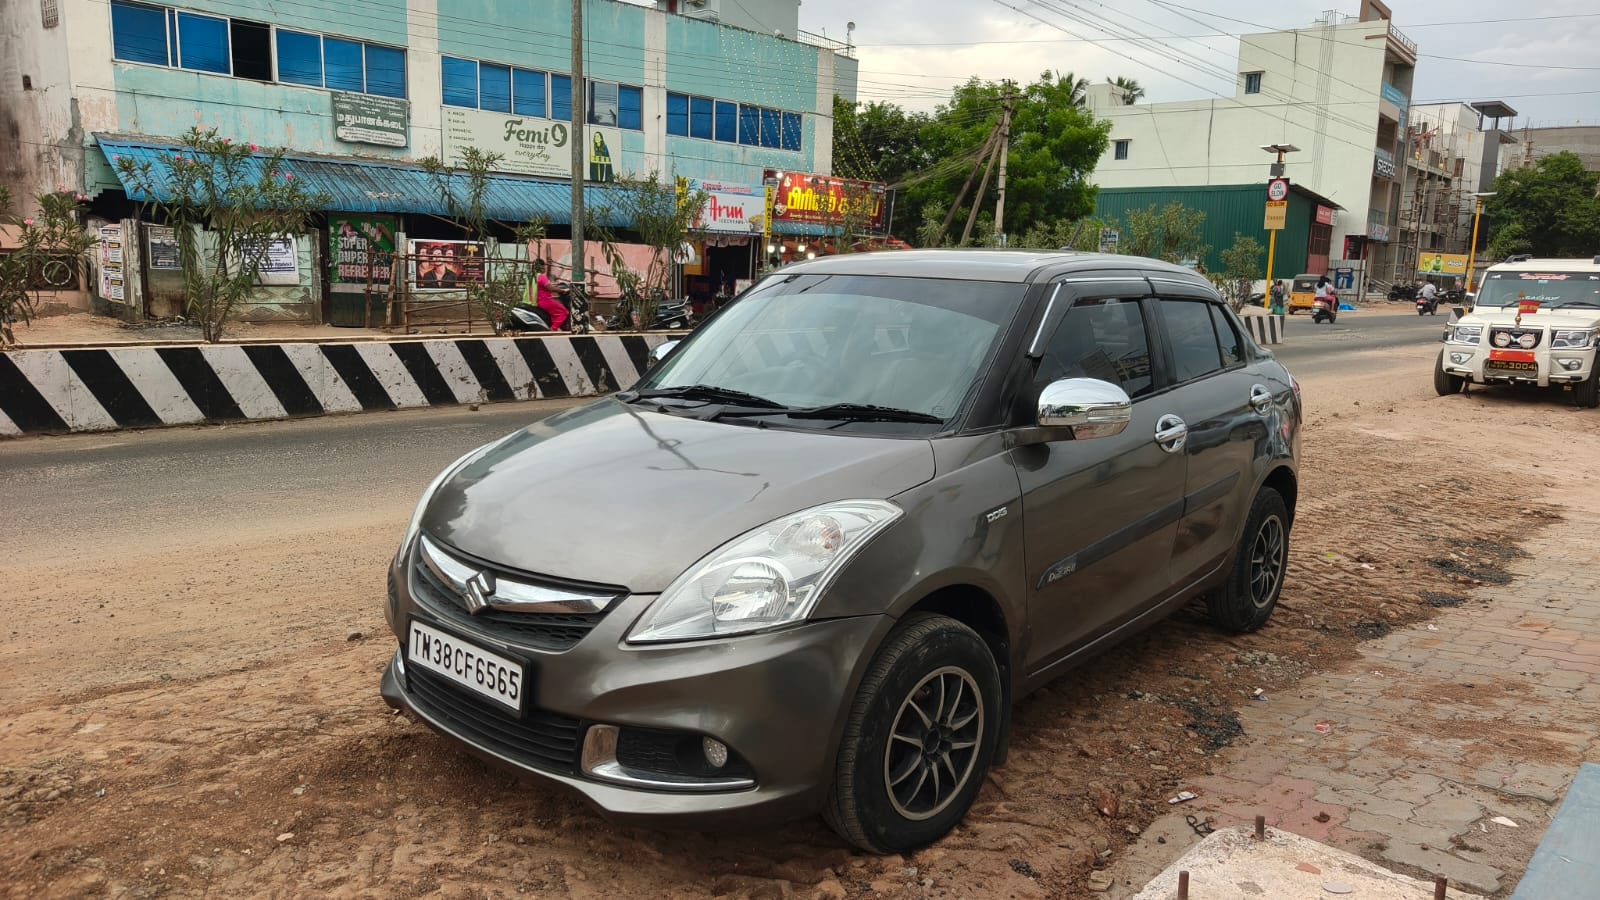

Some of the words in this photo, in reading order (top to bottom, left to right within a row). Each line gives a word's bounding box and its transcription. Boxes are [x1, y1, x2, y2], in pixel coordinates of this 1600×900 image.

[336, 113, 405, 131] மதுபானக்கடை
[514, 148, 552, 162] everyday
[1273, 182, 1282, 190] GO
[708, 194, 743, 222] Arun
[765, 186, 773, 237] LAMINATION
[337, 236, 368, 250] SUPER
[337, 250, 368, 264] DUPER
[337, 264, 391, 279] REFREHER
[1508, 361, 1535, 371] 3004
[413, 628, 520, 700] TN38CF6565
